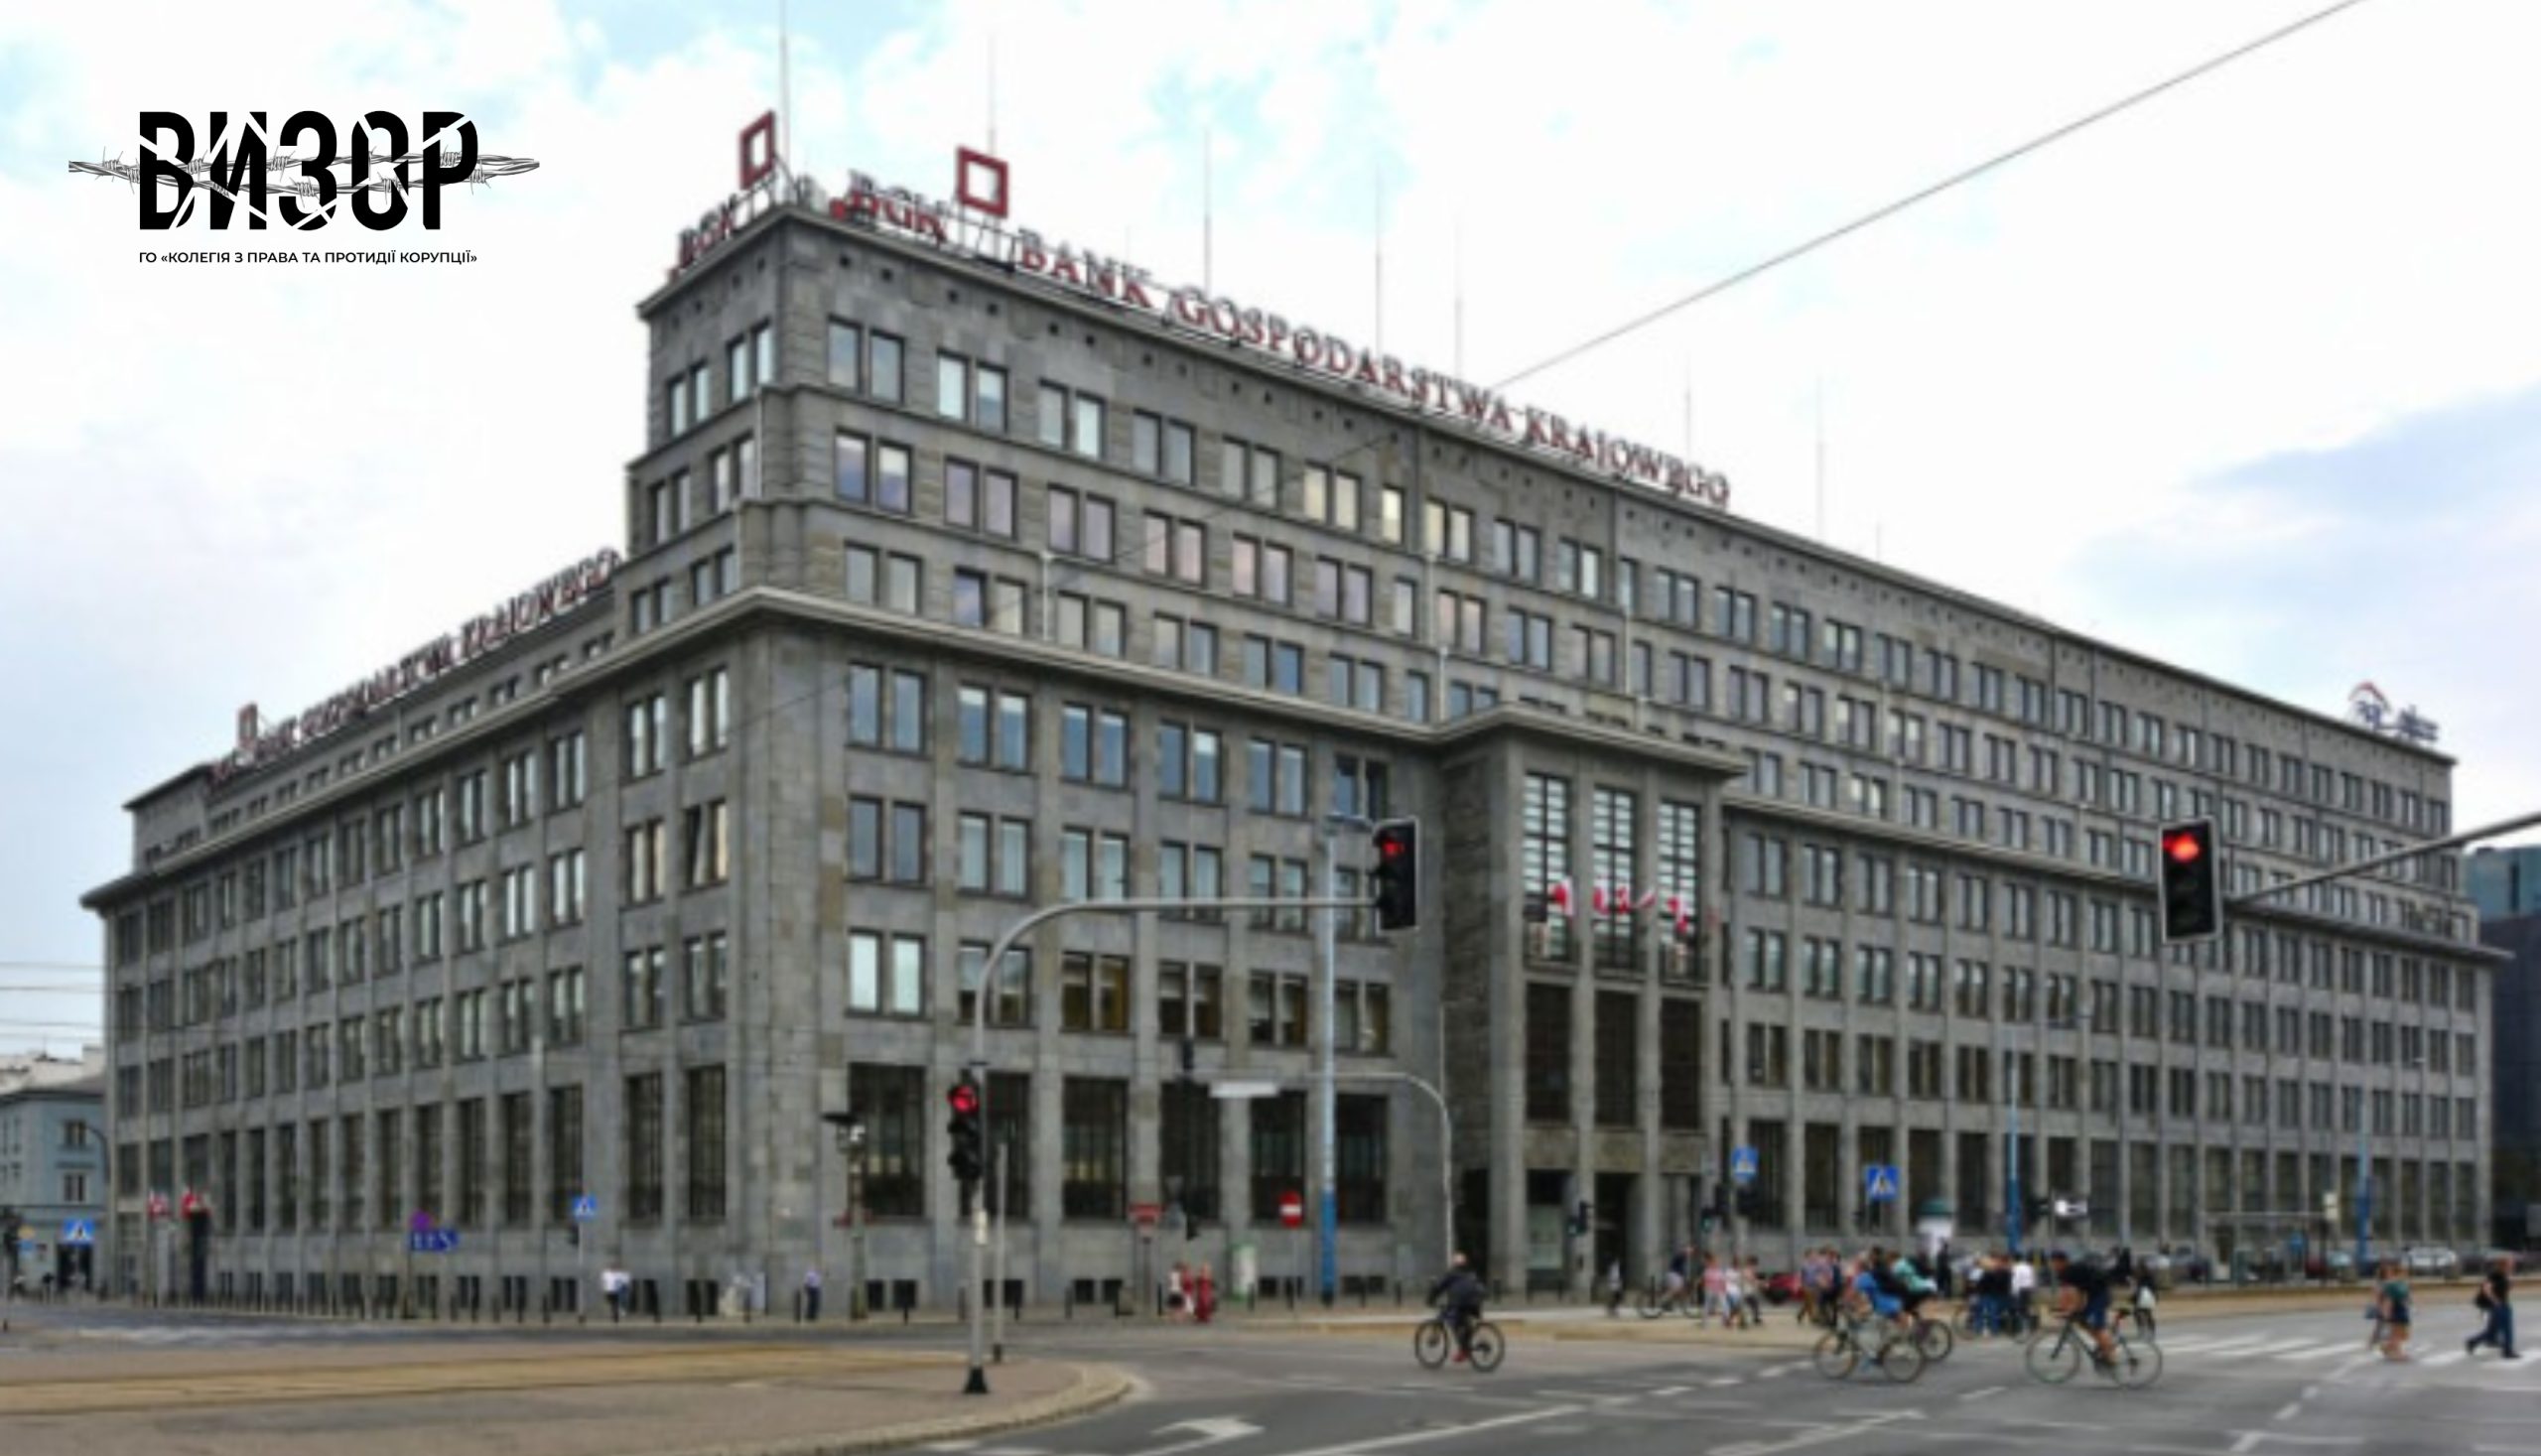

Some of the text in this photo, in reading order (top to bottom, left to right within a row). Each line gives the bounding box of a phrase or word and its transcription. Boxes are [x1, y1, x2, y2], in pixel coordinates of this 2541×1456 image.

[1019, 227, 1731, 503] BANK GOSPODARSTWA KRAJOWEGO
